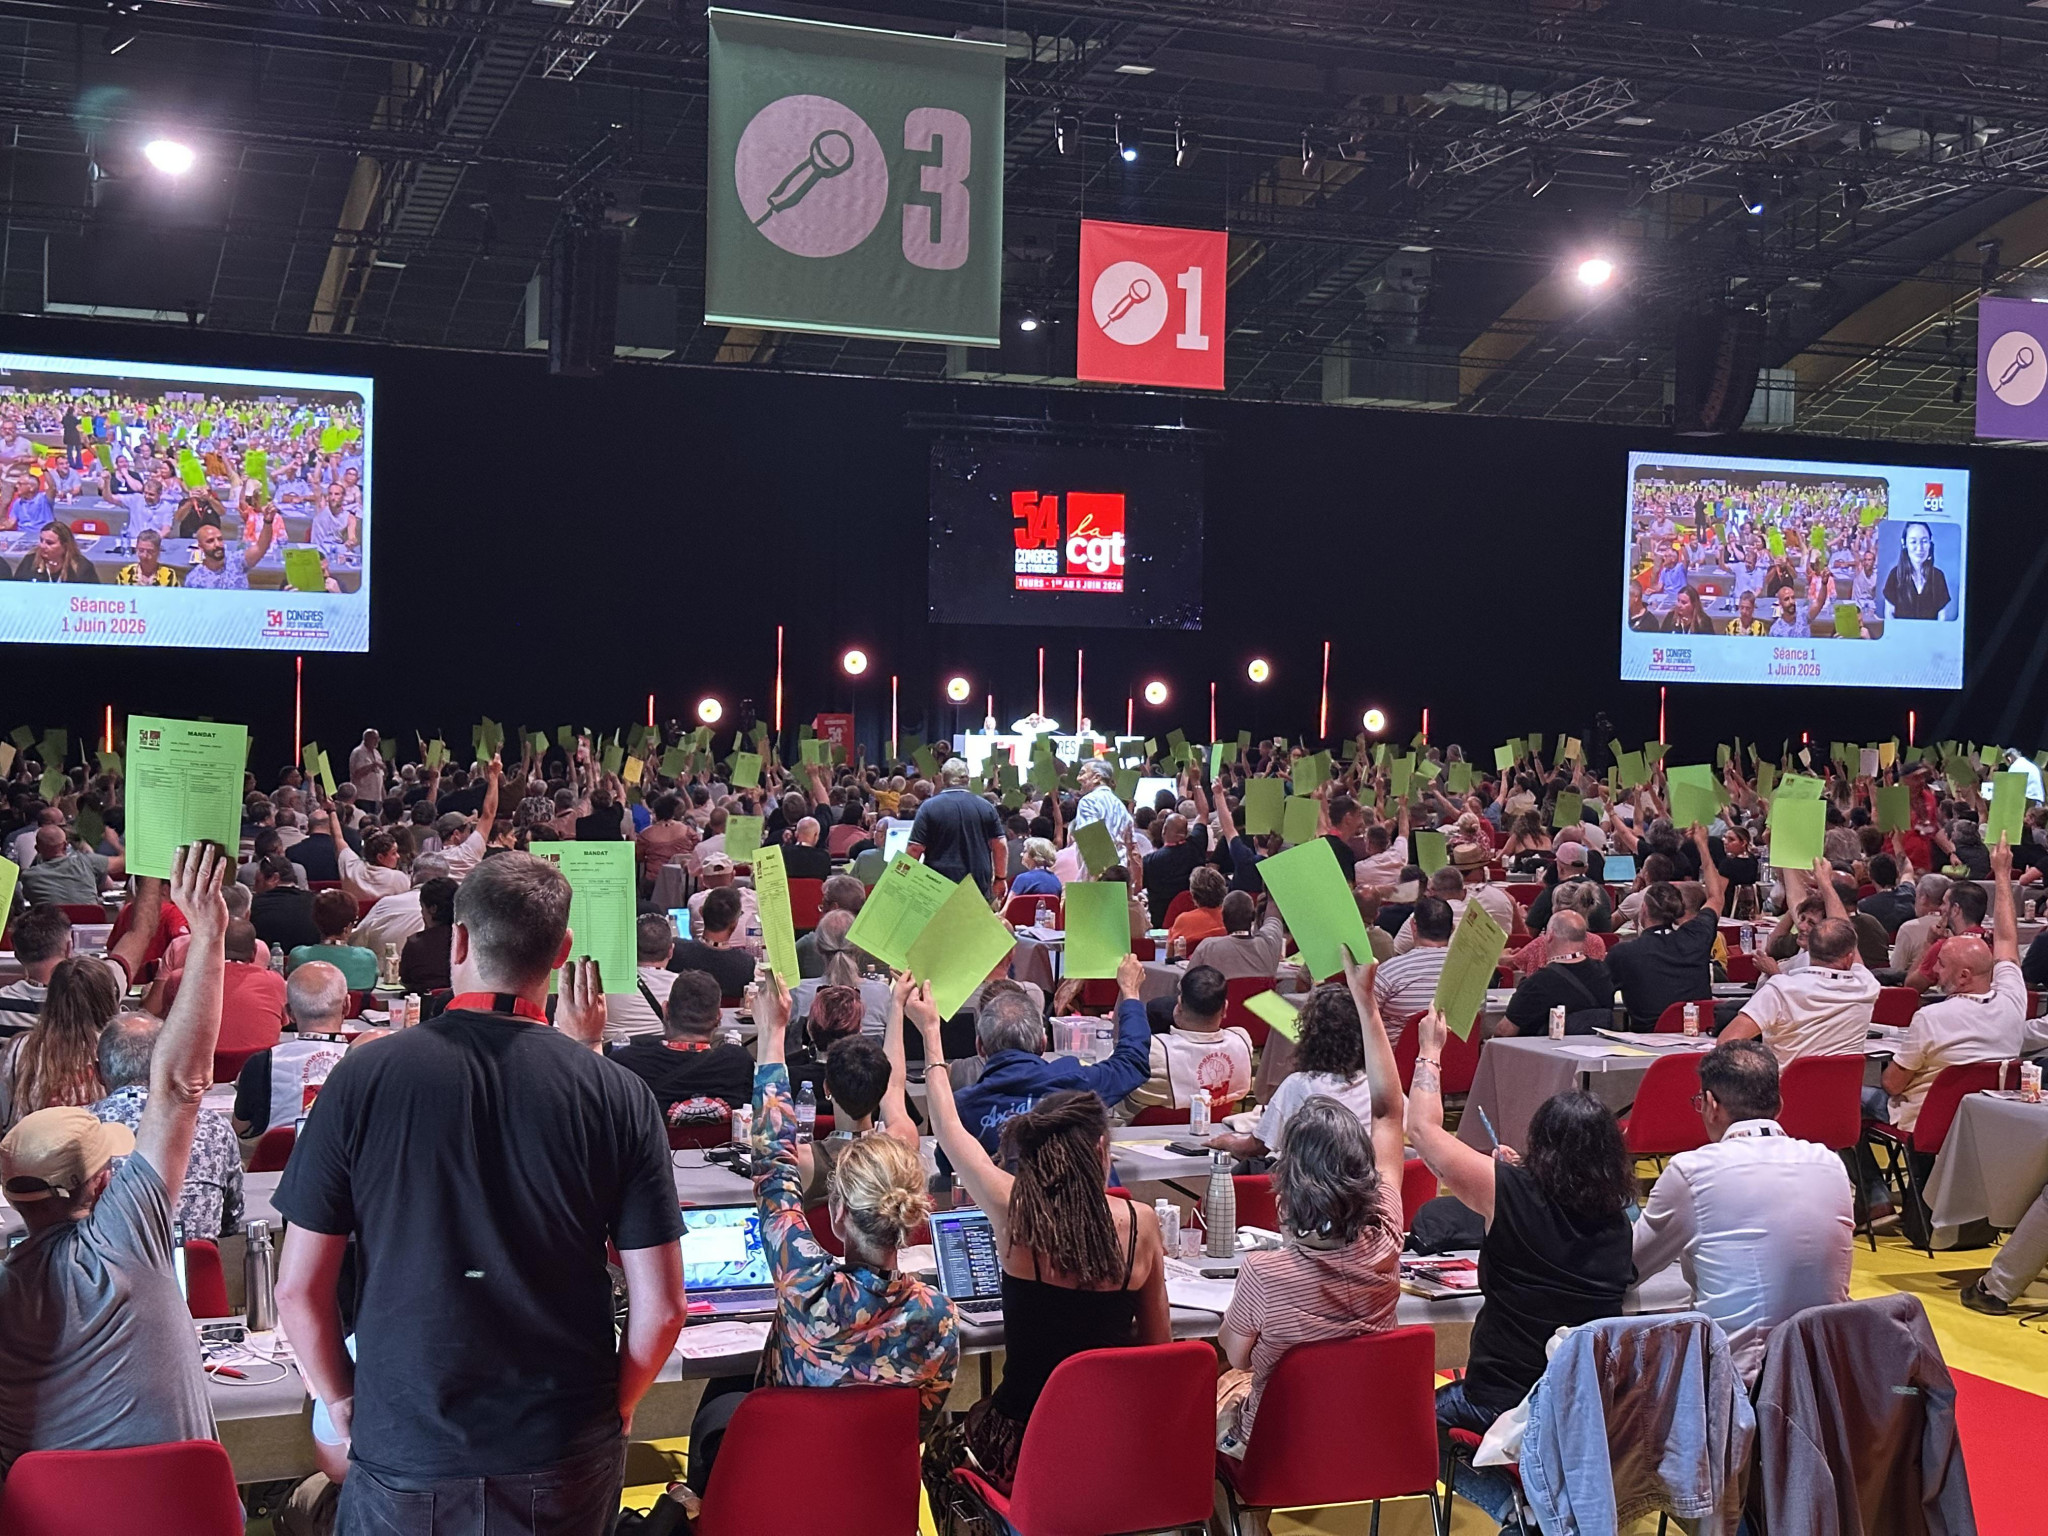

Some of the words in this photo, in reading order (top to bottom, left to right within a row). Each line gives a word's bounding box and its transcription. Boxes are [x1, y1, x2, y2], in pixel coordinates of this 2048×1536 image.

[902, 107, 971, 270] 3
[1176, 266, 1210, 351] 1
[1924, 496, 1943, 511] cgt
[1011, 491, 1059, 549] 54
[1070, 513, 1114, 539] la
[1065, 531, 1125, 573] cgt
[1018, 578, 1044, 588] TOURS
[1063, 580, 1075, 588] AU
[1082, 580, 1101, 590] JUIN
[1102, 580, 1122, 590] 2026
[70, 596, 126, 613] Séance
[129, 598, 138, 614] 1
[61, 616, 69, 632] 1
[74, 616, 106, 633] Juin
[110, 618, 146, 634] 2026
[266, 609, 283, 627] 54
[1773, 647, 1808, 660] Séance
[1810, 648, 1816, 660] 1
[1767, 662, 1773, 675] 1
[1775, 662, 1796, 676] Juin
[1797, 663, 1821, 676] 2026
[187, 730, 217, 738] MANDAT
